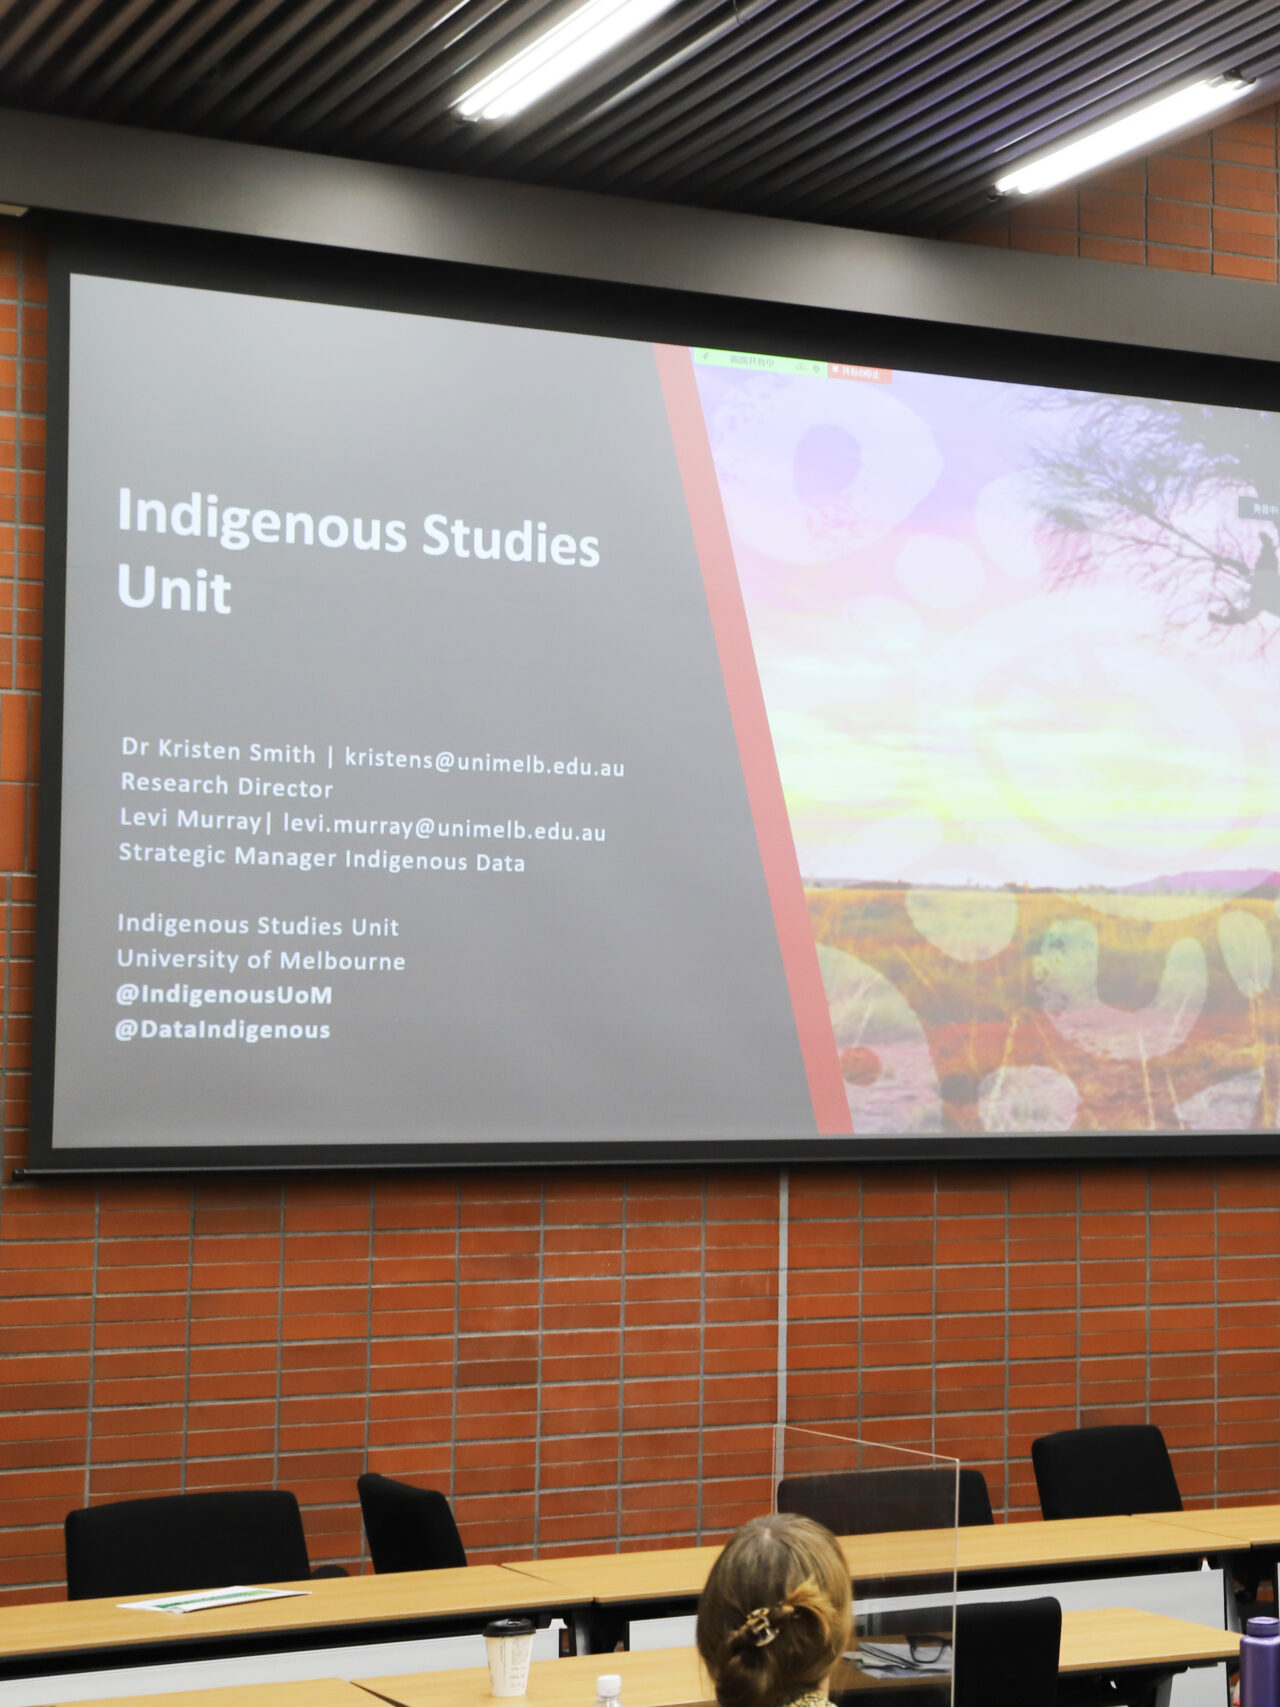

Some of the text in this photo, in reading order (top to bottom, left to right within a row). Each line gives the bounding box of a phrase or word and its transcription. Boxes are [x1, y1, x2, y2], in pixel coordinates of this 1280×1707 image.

[120, 488, 599, 567] Indigenous Studies
[119, 564, 231, 614] Unit
[123, 737, 149, 755] Dr
[159, 739, 240, 760] Kristen
[250, 744, 315, 763] Smith
[346, 746, 624, 776] kristens@unimelb.edu.au
[122, 772, 333, 798] Research Director
[121, 807, 167, 826] Levi
[284, 813, 605, 841] levi.murray@unimelb.edu.au
[120, 843, 524, 873] Strategic Manager Indigenous Data
[119, 912, 399, 937] Indigenous Studies Unit
[118, 948, 405, 973] University of Melbourne
[116, 983, 332, 1007] @IndigenousUoM
[115, 1019, 330, 1043] @DataIndigenous
